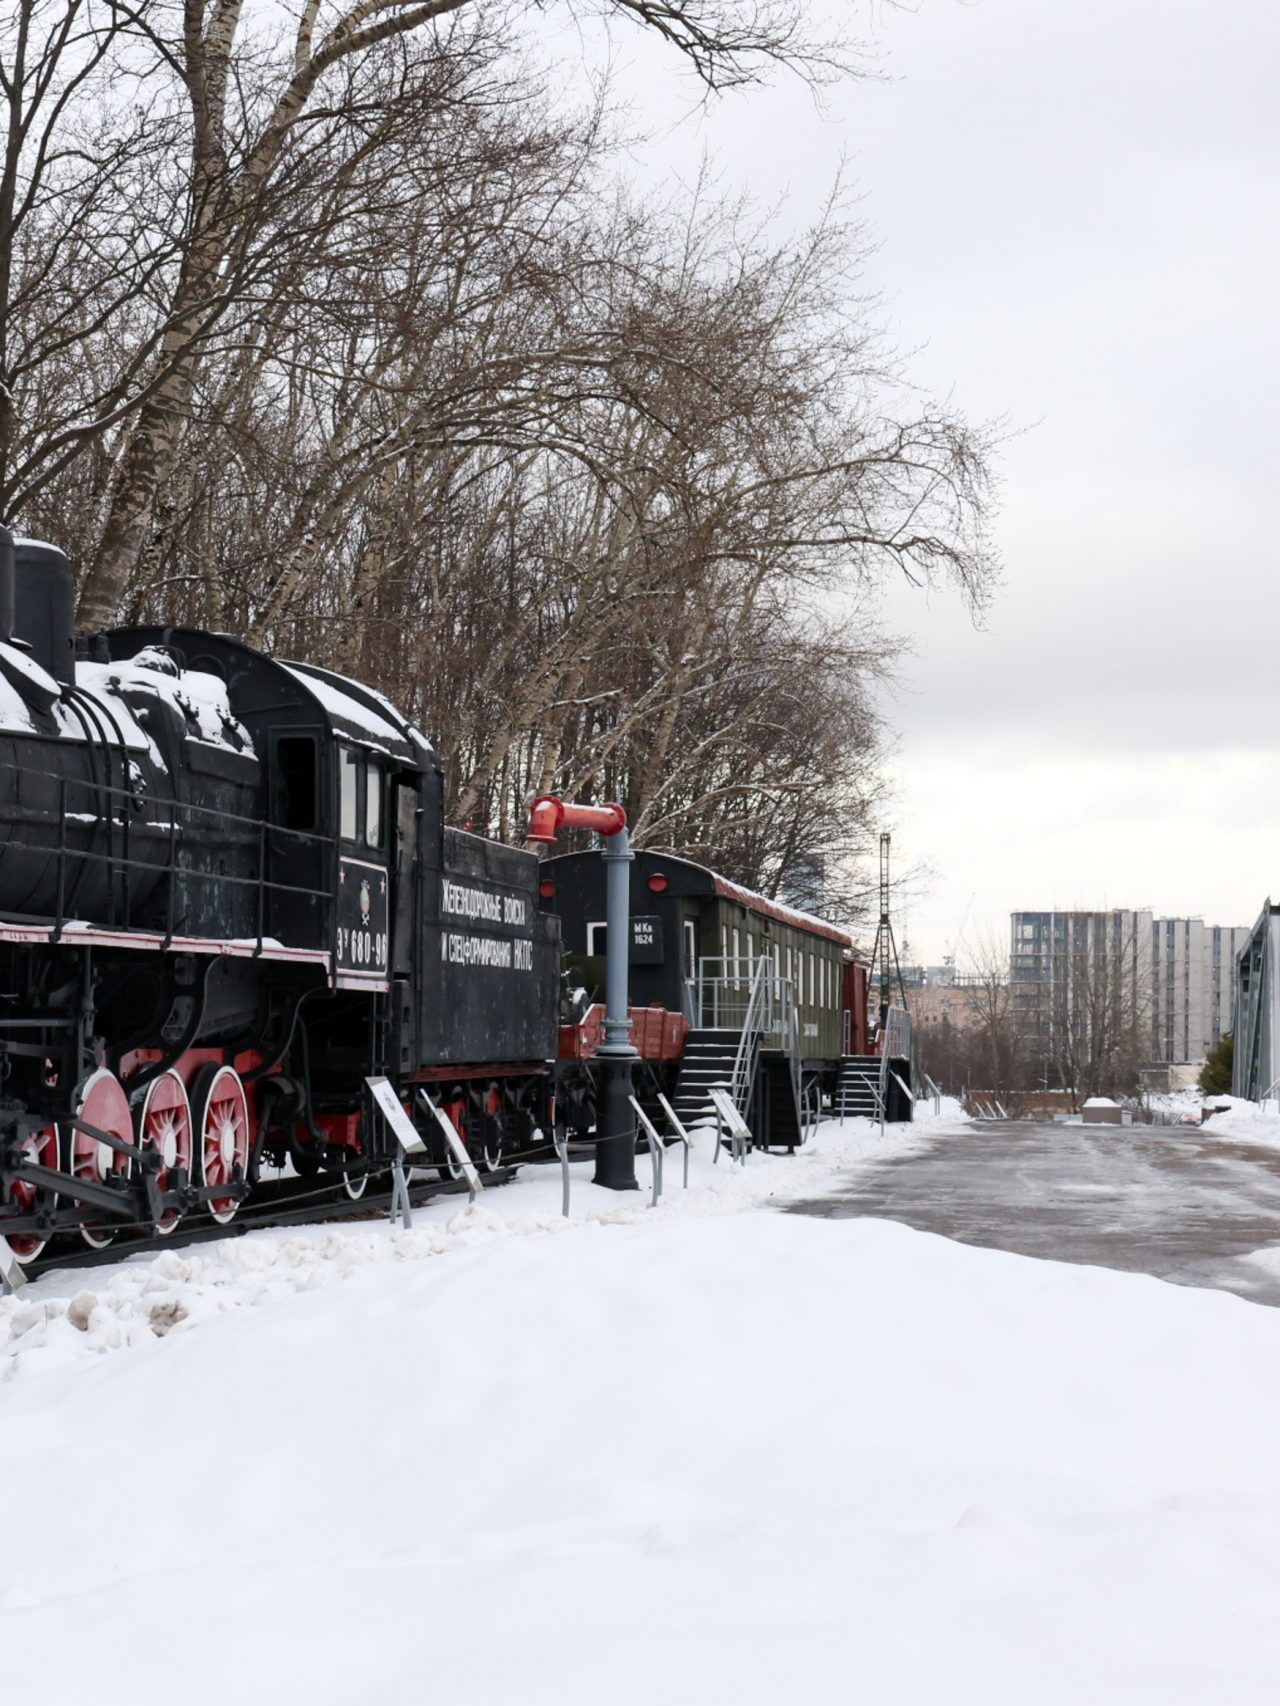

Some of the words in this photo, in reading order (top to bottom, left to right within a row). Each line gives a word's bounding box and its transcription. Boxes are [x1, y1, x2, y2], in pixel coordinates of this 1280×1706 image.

[504, 893, 525, 928] ВОЙСКА
[441, 931, 448, 961] И
[513, 938, 533, 971] НКПС
[634, 934, 653, 944] 1624
